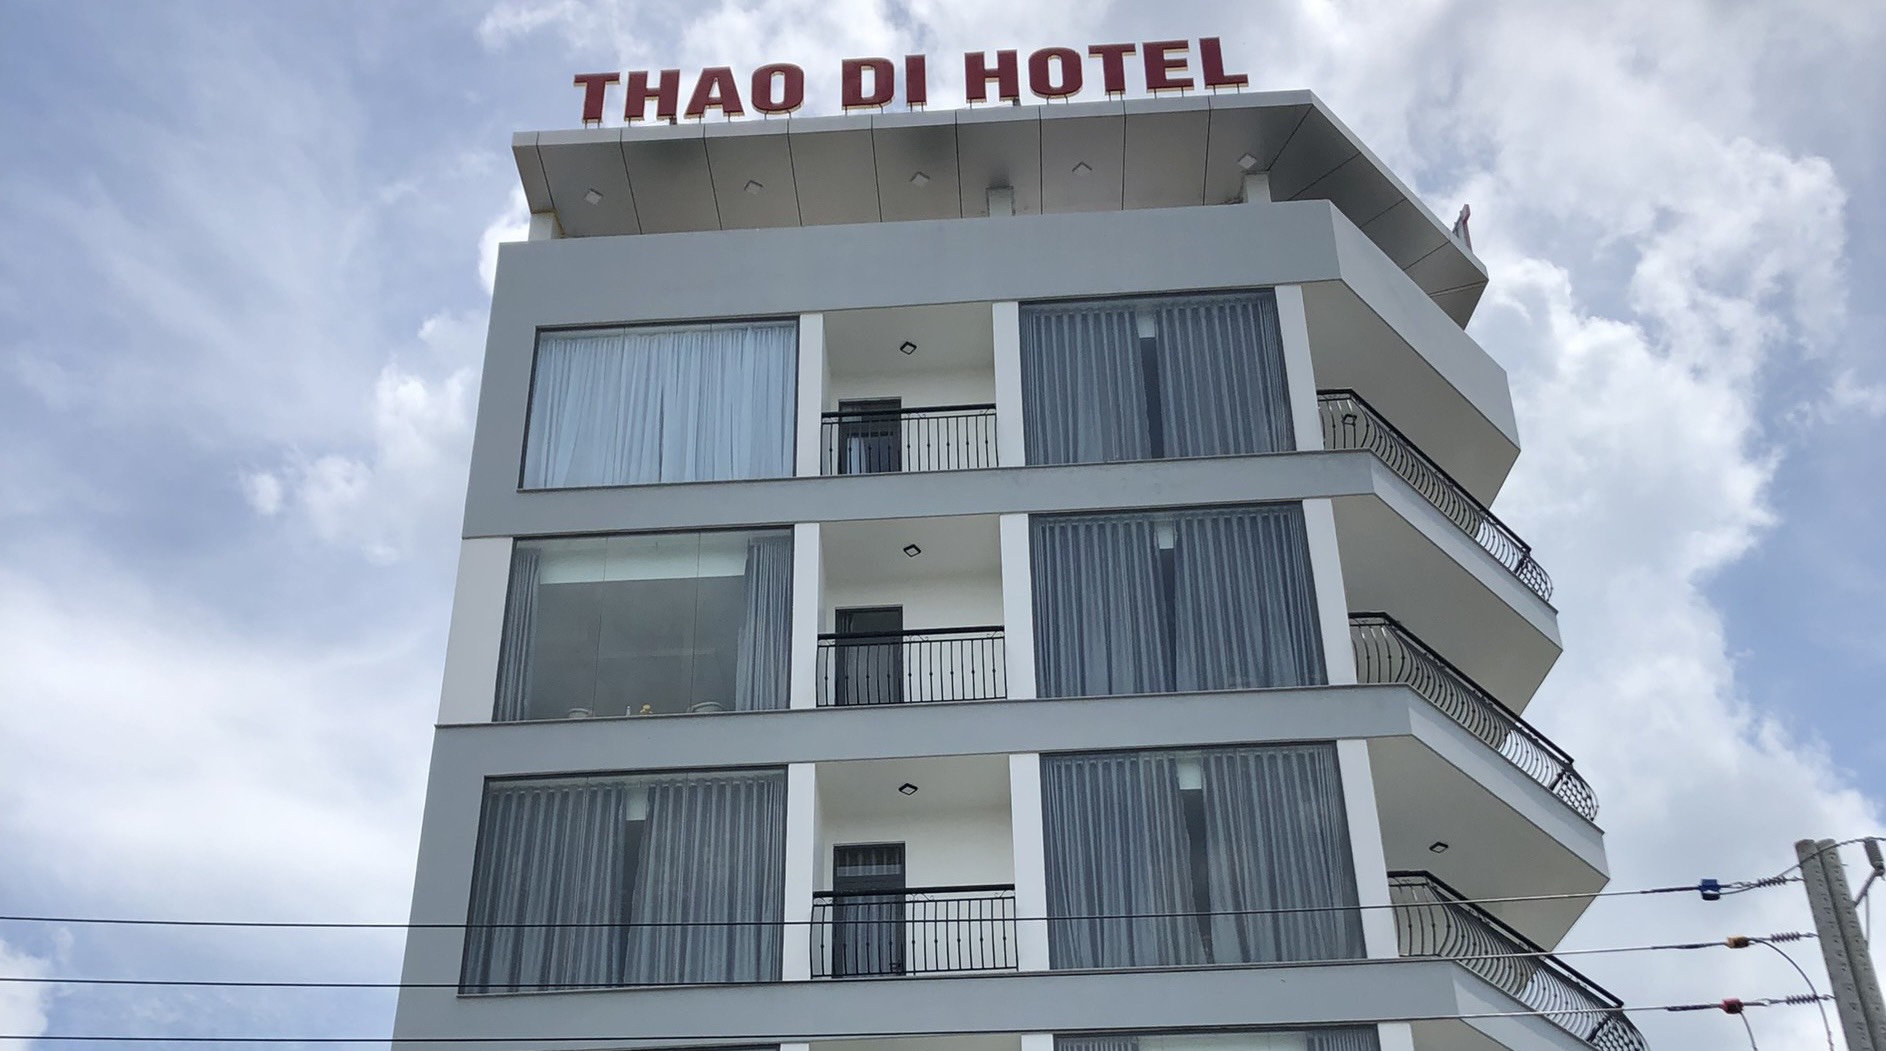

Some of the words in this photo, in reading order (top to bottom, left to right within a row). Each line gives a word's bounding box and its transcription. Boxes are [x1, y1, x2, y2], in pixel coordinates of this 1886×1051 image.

[573, 62, 805, 122] THAO
[842, 55, 927, 108] DI
[965, 37, 1249, 102] HOTEL
